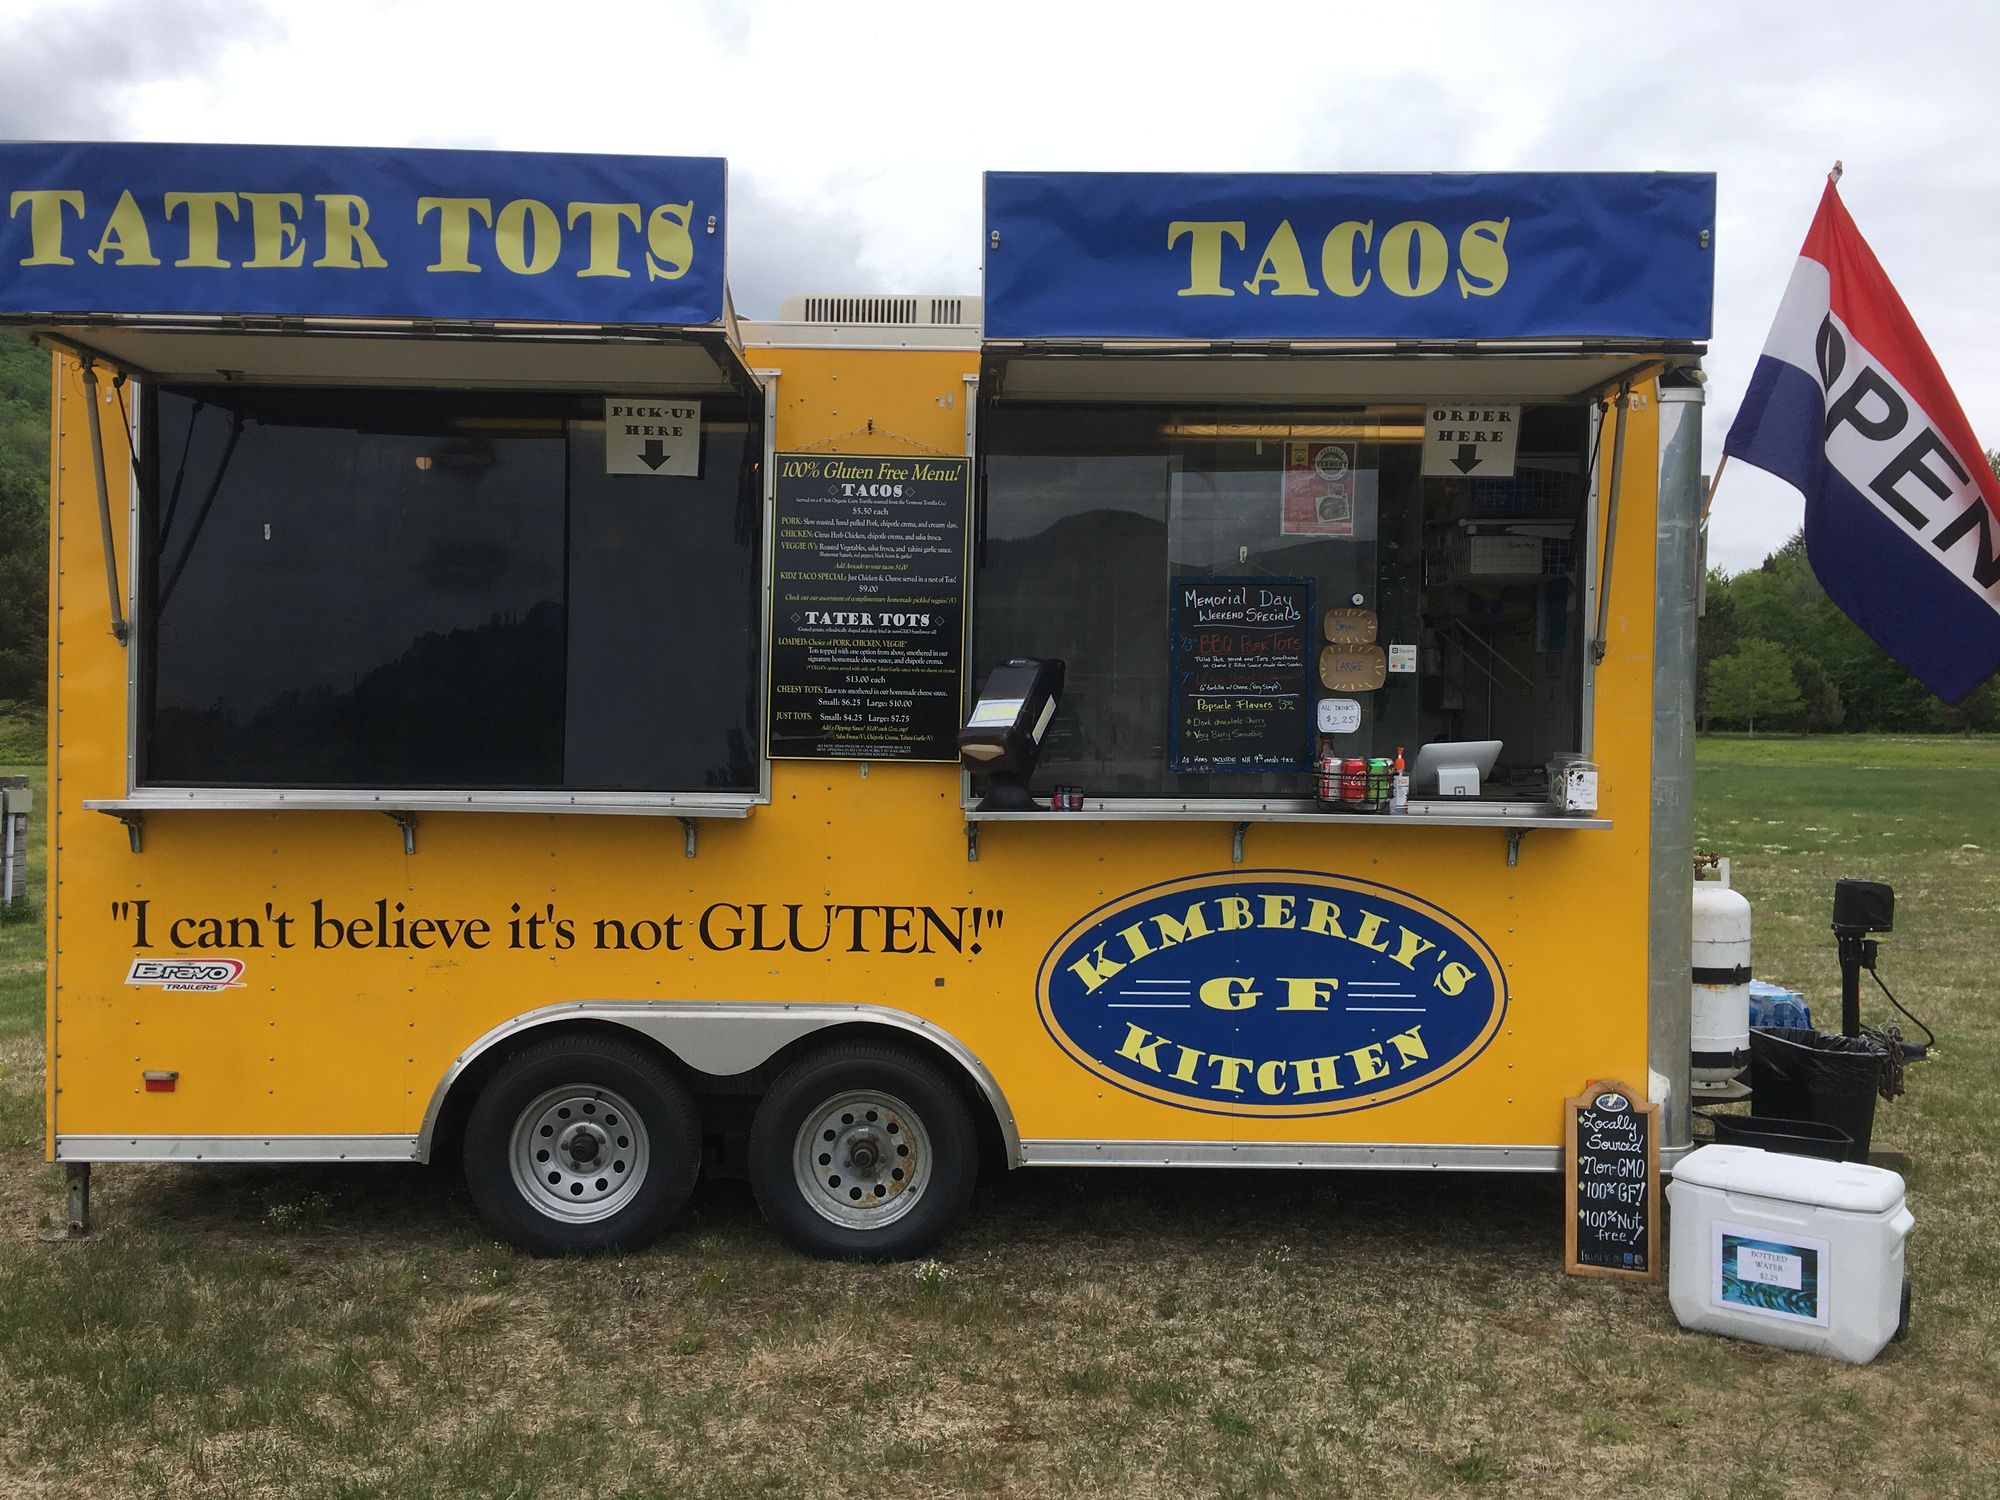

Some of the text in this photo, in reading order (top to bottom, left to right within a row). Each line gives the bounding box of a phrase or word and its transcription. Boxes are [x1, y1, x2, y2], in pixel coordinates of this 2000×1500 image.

[10, 188, 693, 282] TATER TOTS
[1167, 216, 1511, 300] TACOS
[611, 406, 695, 419] PICK-UP
[1432, 409, 1512, 422] ORDER
[624, 424, 683, 437] HERE
[1438, 430, 1504, 442] HERE
[1815, 310, 2000, 589] OPEN
[782, 461, 962, 481] 100% Gluten Free Menu!
[841, 483, 903, 498] TACOS
[852, 506, 889, 516] $5.50 each
[781, 517, 802, 525] PORK:
[850, 519, 865, 527] pulled
[880, 520, 900, 528] chipotle
[780, 530, 814, 538] CHICKEN:
[844, 532, 867, 540] Chicken,
[868, 532, 887, 540] chipotle
[782, 542, 806, 550] VEGGIE
[1260, 590, 1294, 618] Day
[805, 612, 930, 627] TATER TOTS
[778, 637, 808, 646] LOADED:
[1200, 634, 1233, 655] BBQ
[905, 657, 925, 665] chipotle
[776, 685, 802, 693] CHEESY
[818, 698, 840, 706] Small:
[867, 699, 888, 708] Large:
[1197, 698, 1232, 712] Popsicle
[1236, 699, 1274, 710] Flavors
[776, 712, 792, 720] JUST
[868, 714, 889, 723] Large:
[1326, 715, 1356, 725] $2.25
[112, 898, 1003, 954] "I can't believe it's not GLUTEN!"
[1067, 894, 1476, 996] KIMBERLY'S
[132, 962, 228, 980] Bravo
[1114, 1022, 1430, 1095] KITCHEN
[1584, 1110, 1637, 1142] Locally
[1586, 1134, 1644, 1153] Sourced
[1584, 1156, 1645, 1179] Non-GMO
[1587, 1182, 1646, 1206] 100% GF!
[1586, 1210, 1642, 1230] 100% Nut
[1751, 1250, 1788, 1262] BOTTLED
[1754, 1261, 1784, 1272] WATER
[1760, 1273, 1778, 1282] $2.25
